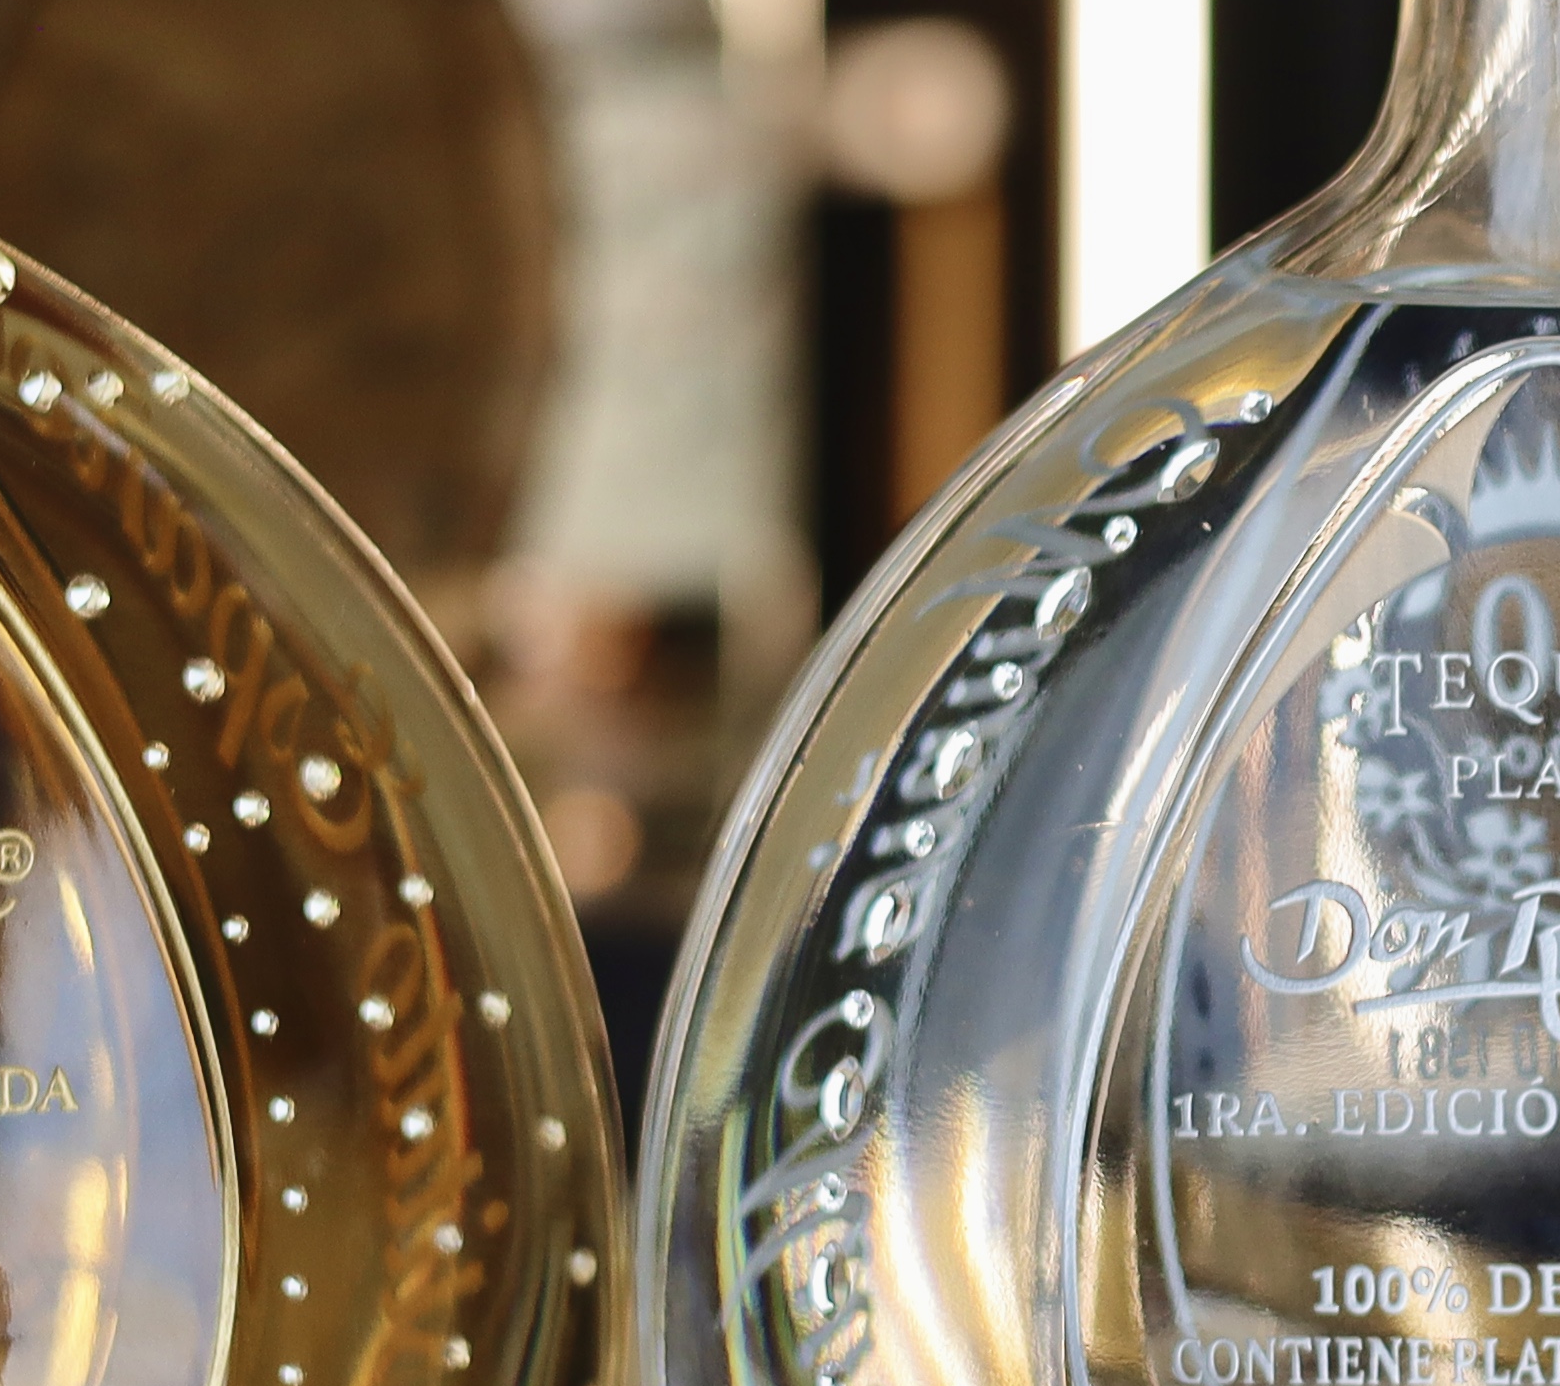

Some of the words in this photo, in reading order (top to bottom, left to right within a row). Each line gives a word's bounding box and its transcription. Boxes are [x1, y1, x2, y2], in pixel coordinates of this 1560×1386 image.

[1241, 878, 1477, 995] Don
[1173, 1089, 1309, 1140] 1RA.
[1311, 1263, 1472, 1318] 100%
